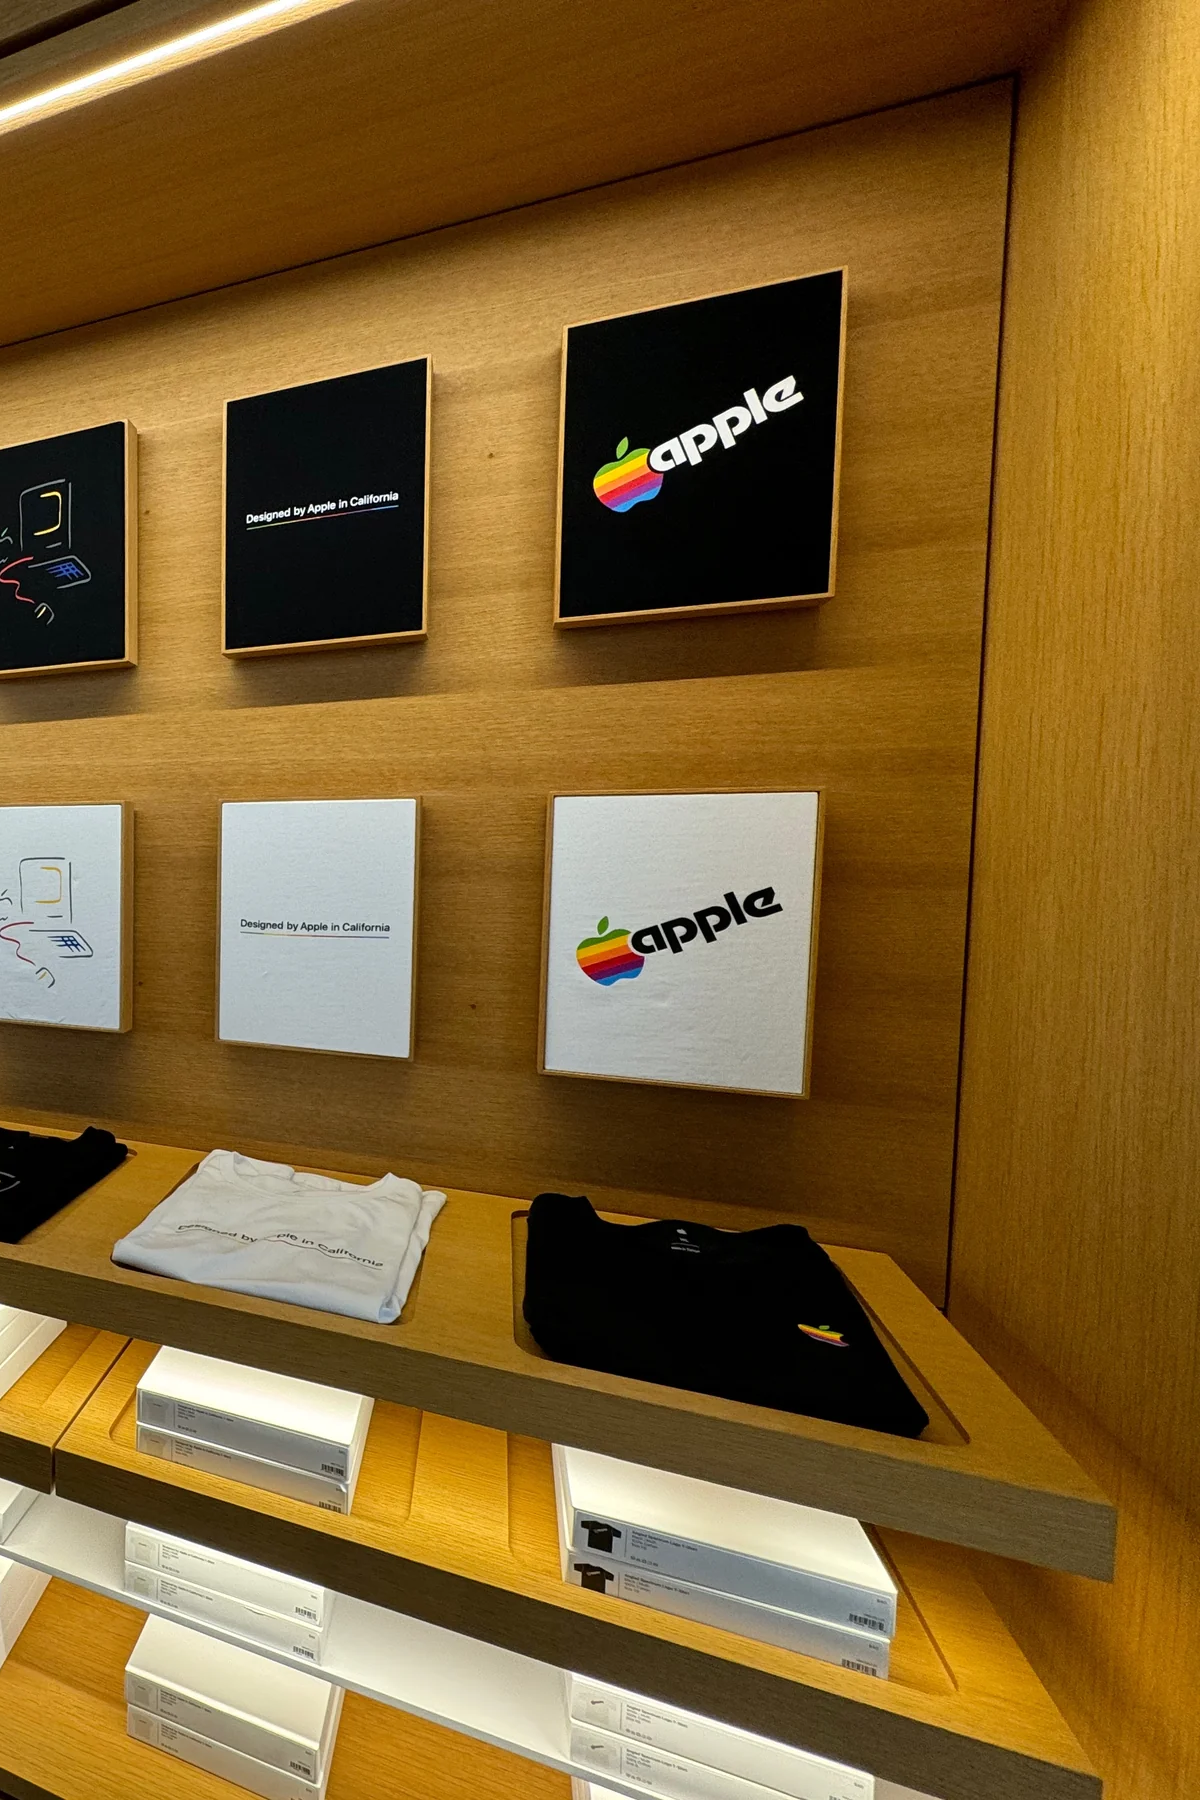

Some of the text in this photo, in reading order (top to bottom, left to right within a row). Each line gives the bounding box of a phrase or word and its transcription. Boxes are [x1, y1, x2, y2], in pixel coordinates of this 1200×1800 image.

[649, 374, 805, 472] apple
[246, 490, 400, 525] Designed by Apple in California
[240, 918, 391, 933] Designed by Apple in California
[631, 886, 784, 955] apple
[240, 1233, 258, 1244] by
[301, 1238, 315, 1246] in
[317, 1242, 384, 1268] California
